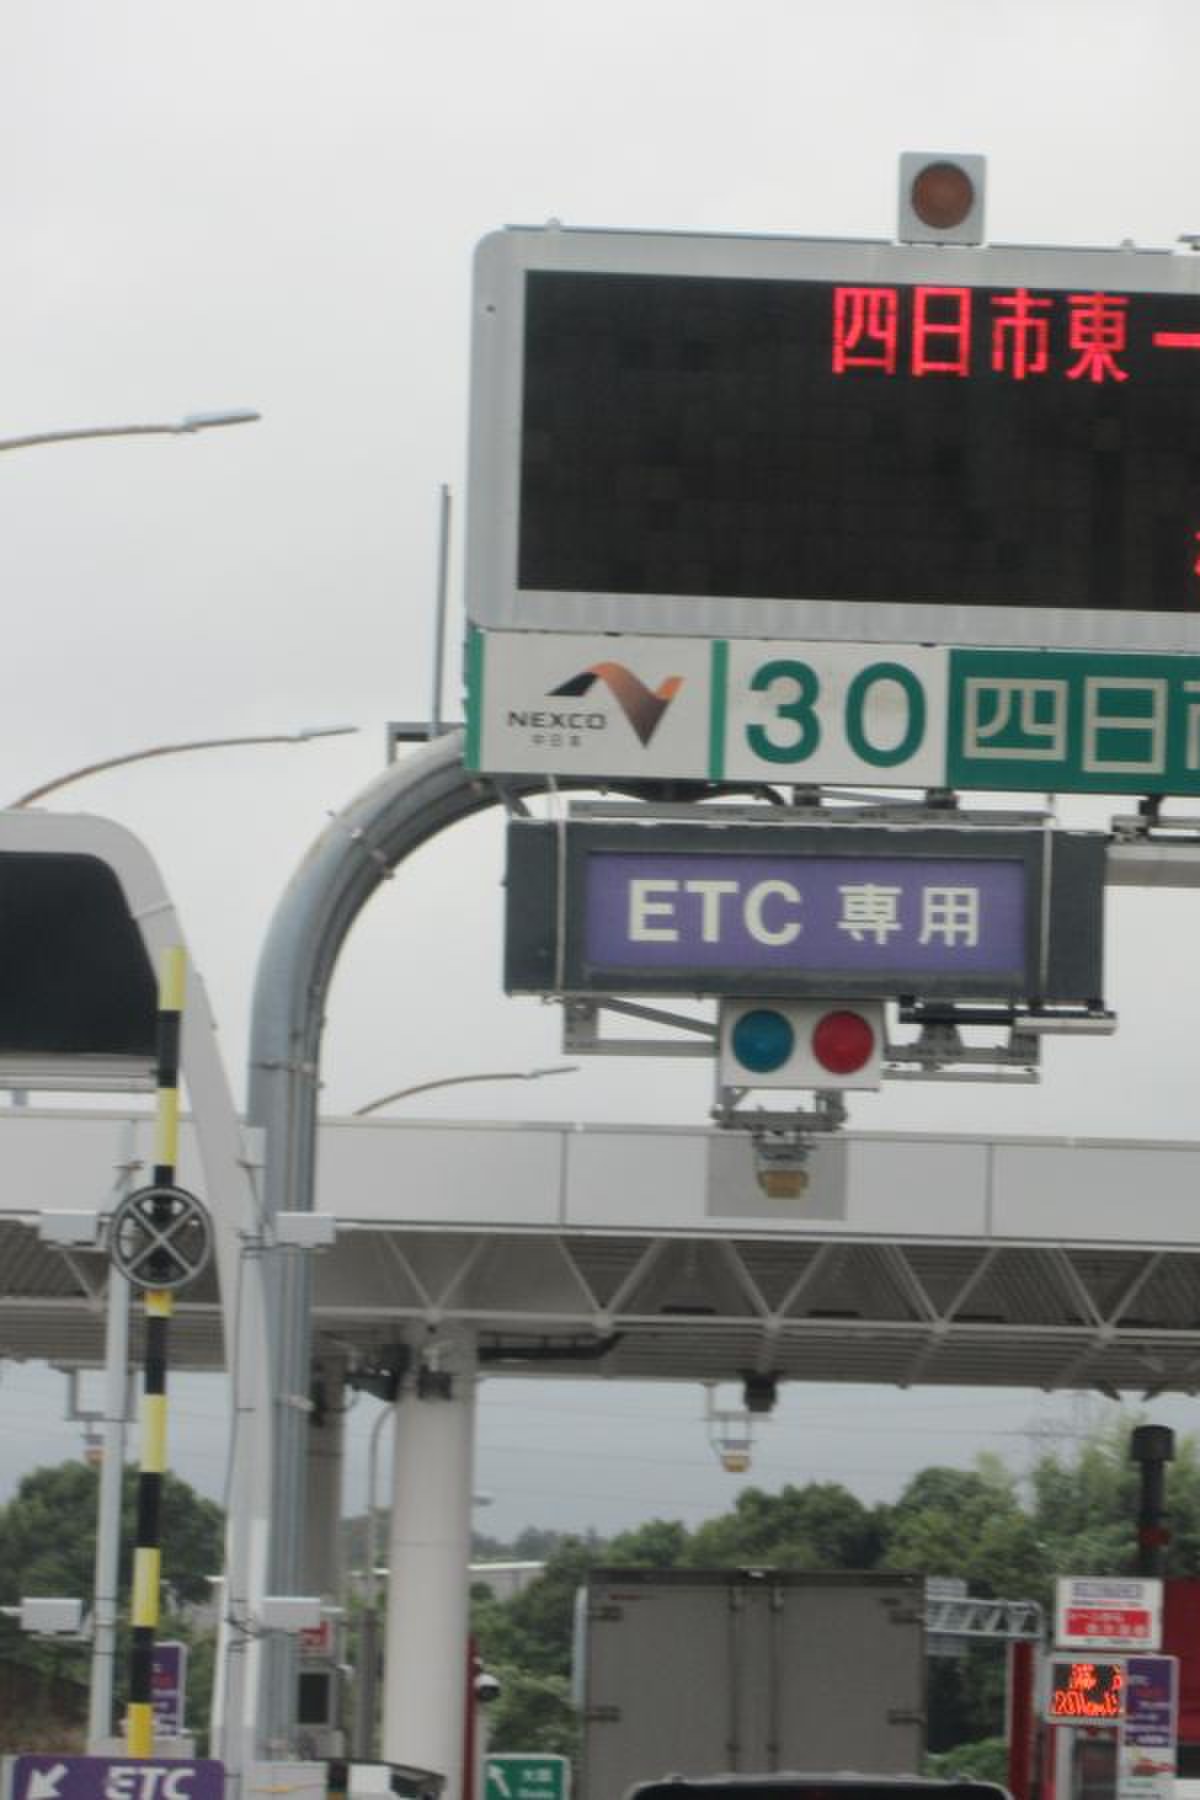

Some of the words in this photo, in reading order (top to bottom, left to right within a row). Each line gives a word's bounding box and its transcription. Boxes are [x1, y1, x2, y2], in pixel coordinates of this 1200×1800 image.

[507, 711, 606, 730] NEXCO
[746, 660, 926, 767] 30
[627, 879, 803, 946] ETC
[836, 882, 981, 948] 専用
[105, 1766, 195, 1800] ETC
